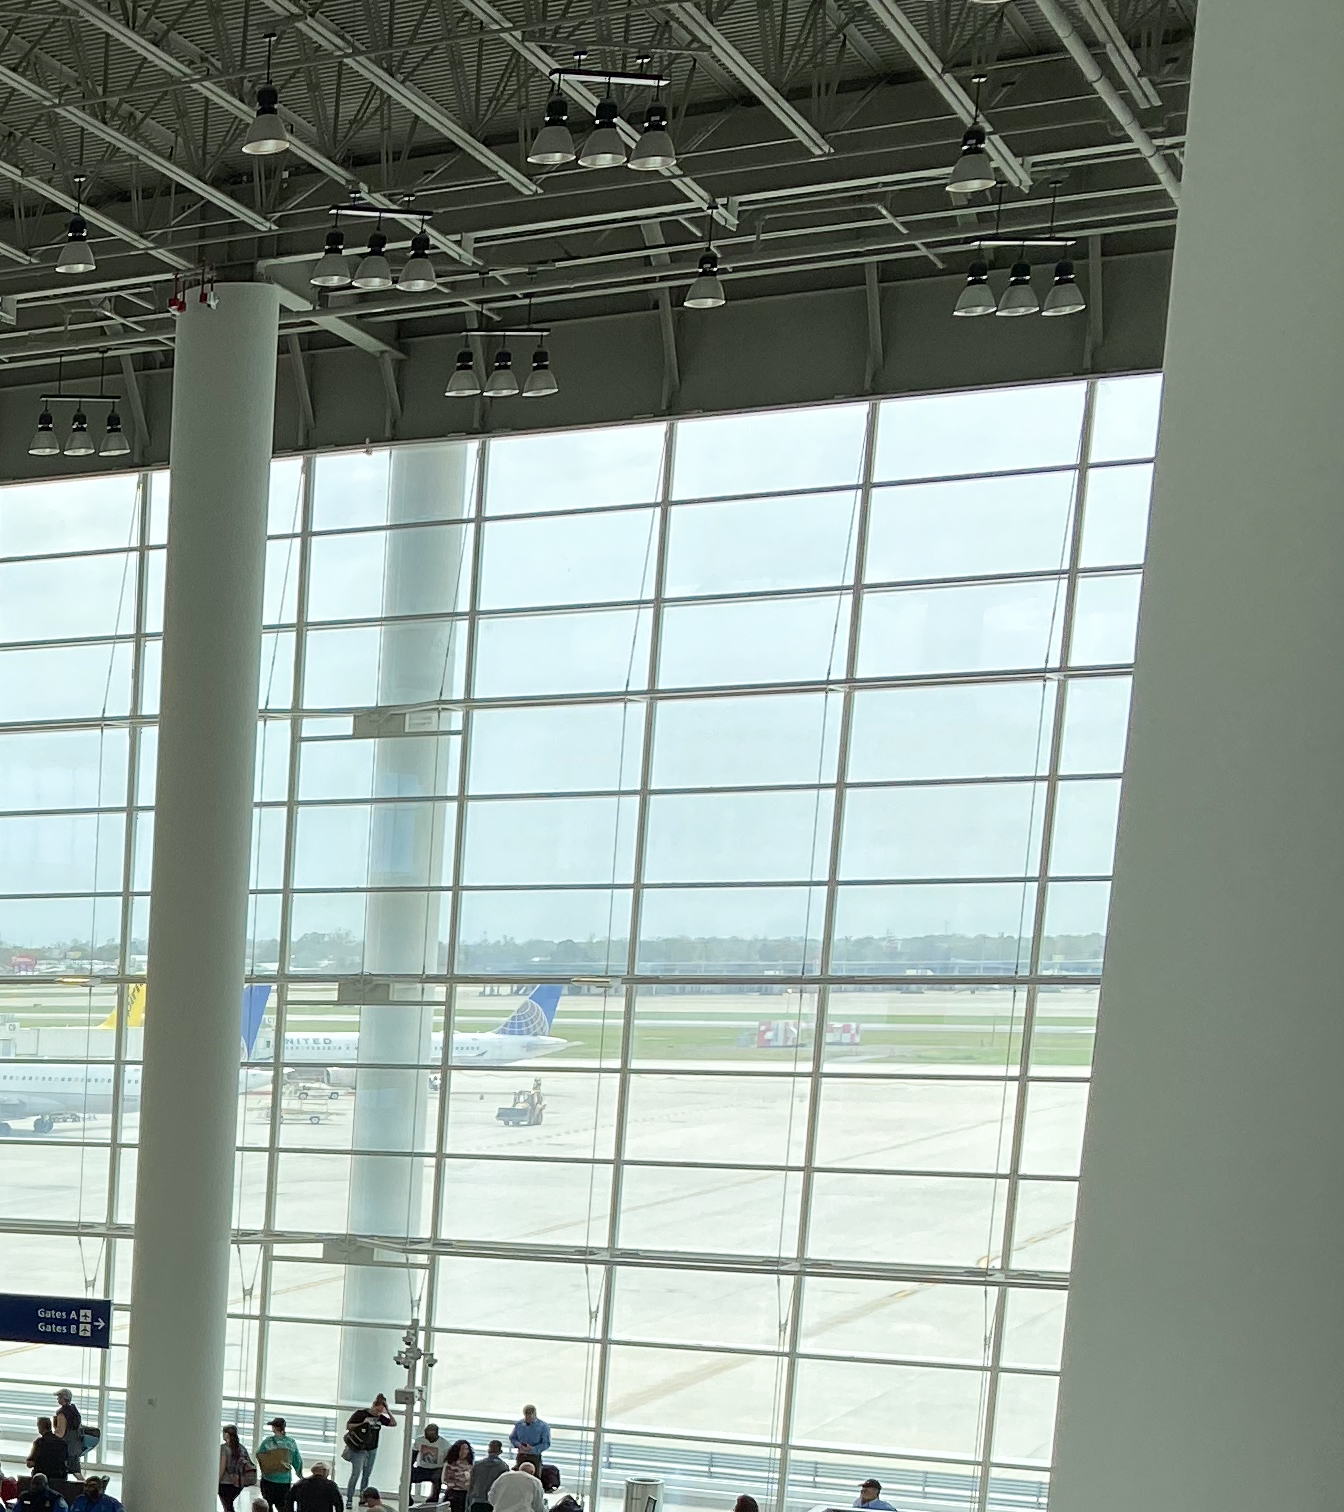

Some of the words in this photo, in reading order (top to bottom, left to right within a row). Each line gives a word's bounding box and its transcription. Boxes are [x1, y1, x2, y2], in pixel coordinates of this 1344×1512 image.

[285, 1037, 332, 1045] NITED
[37, 1307, 67, 1319] Gates
[69, 1310, 78, 1320] A
[37, 1321, 68, 1333] Gates
[70, 1324, 77, 1334] B
